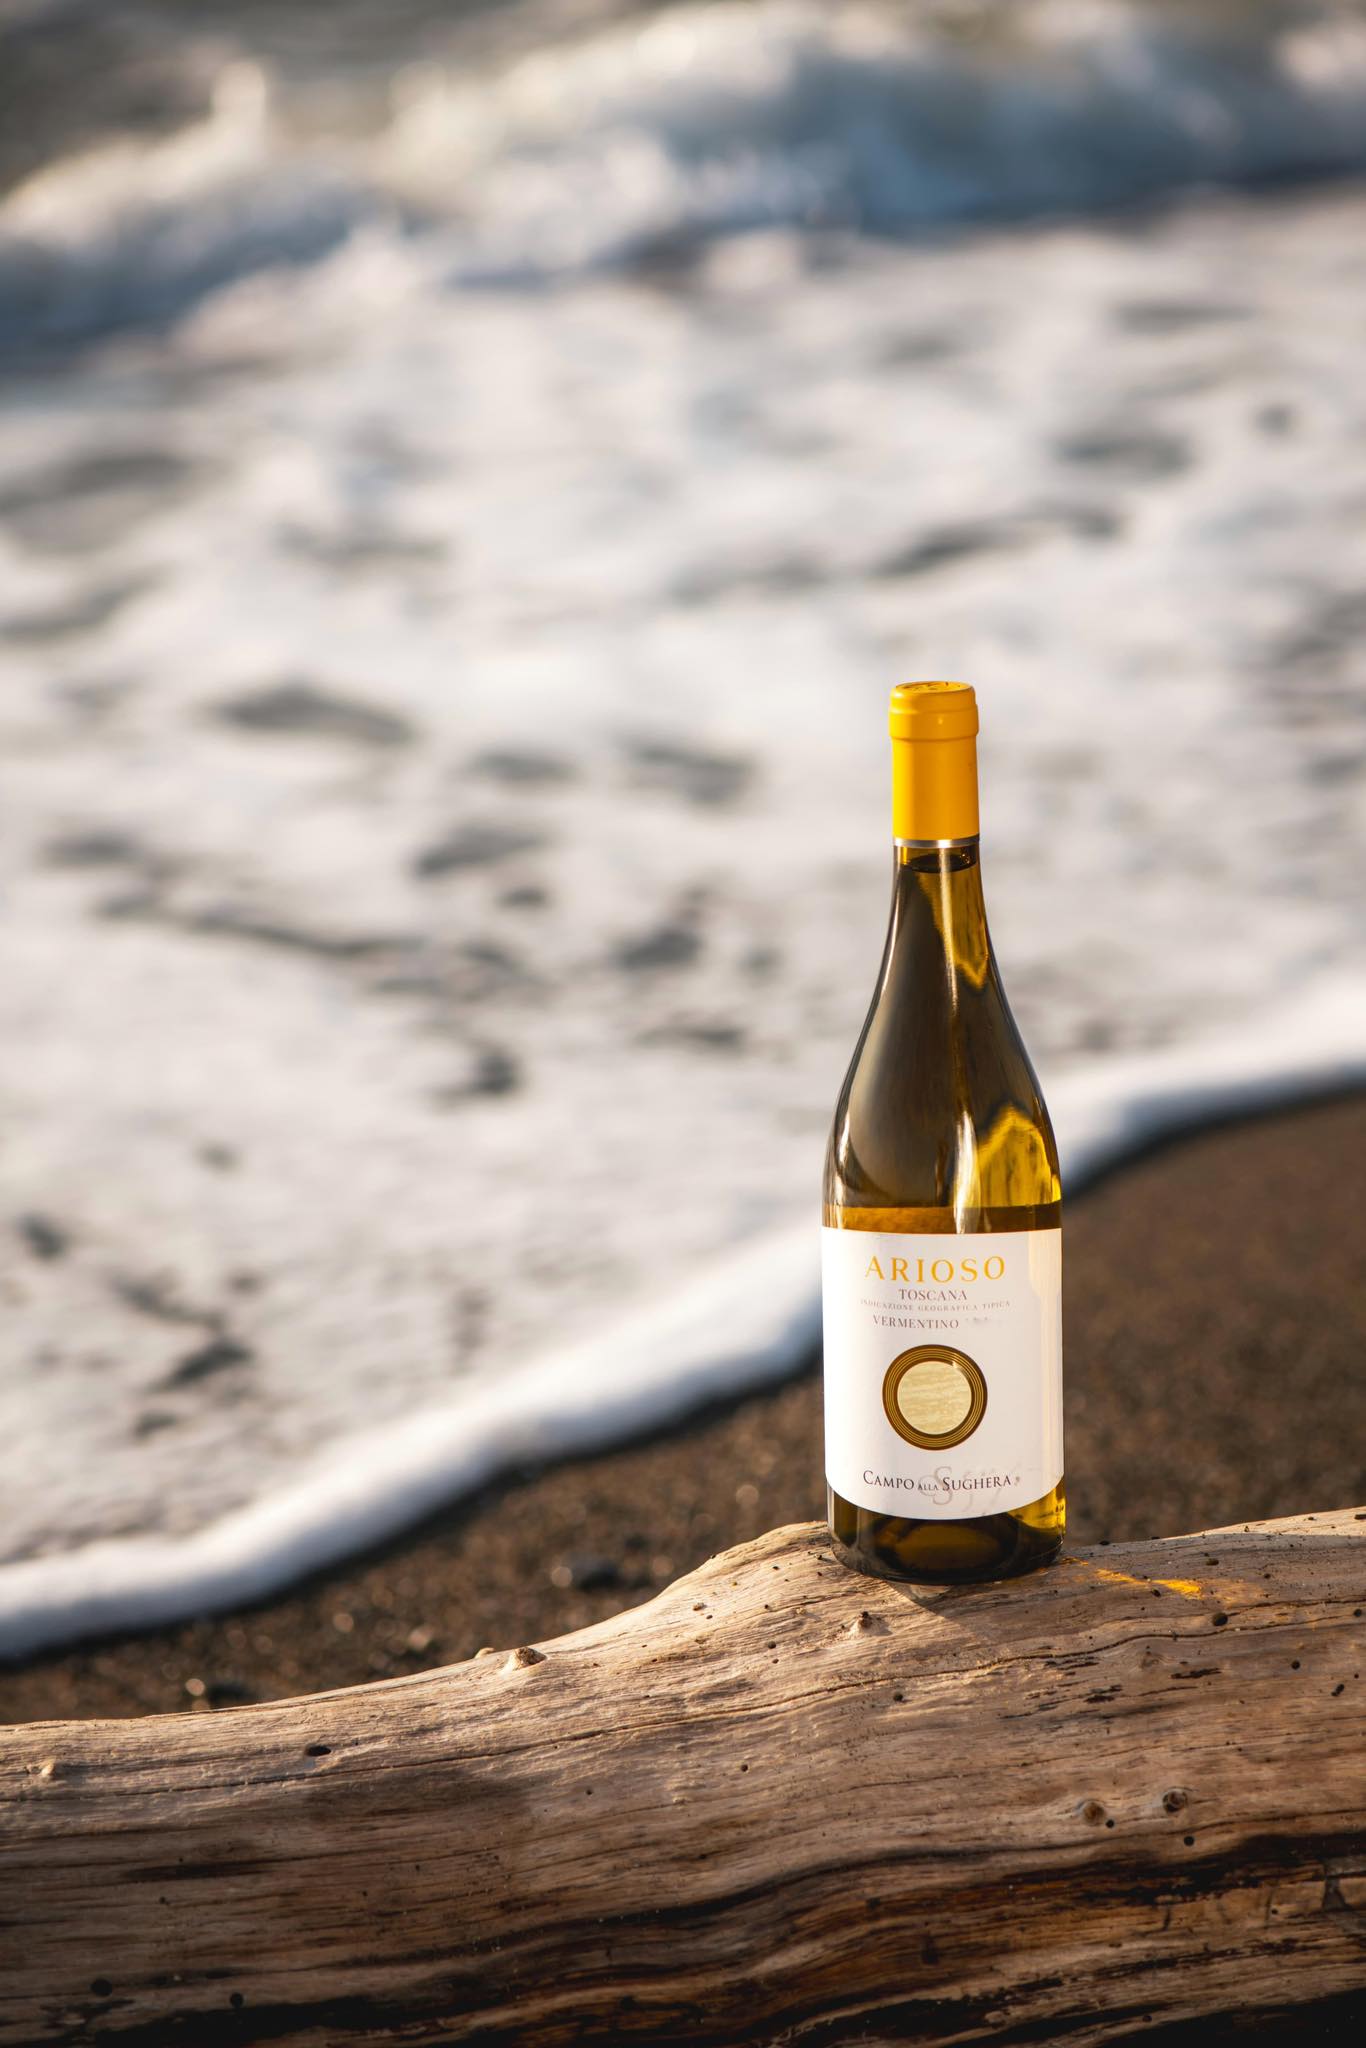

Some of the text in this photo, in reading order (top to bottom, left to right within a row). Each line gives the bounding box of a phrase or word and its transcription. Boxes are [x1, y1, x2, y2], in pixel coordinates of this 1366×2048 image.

[864, 1255, 1006, 1284] ARIOSO
[899, 1288, 968, 1302] TOSCANA
[981, 1300, 1011, 1310] TIPICA
[872, 1314, 960, 1329] VERMENTINO
[862, 1469, 915, 1491] CAMPO
[941, 1475, 1012, 1492] SUGHERA
